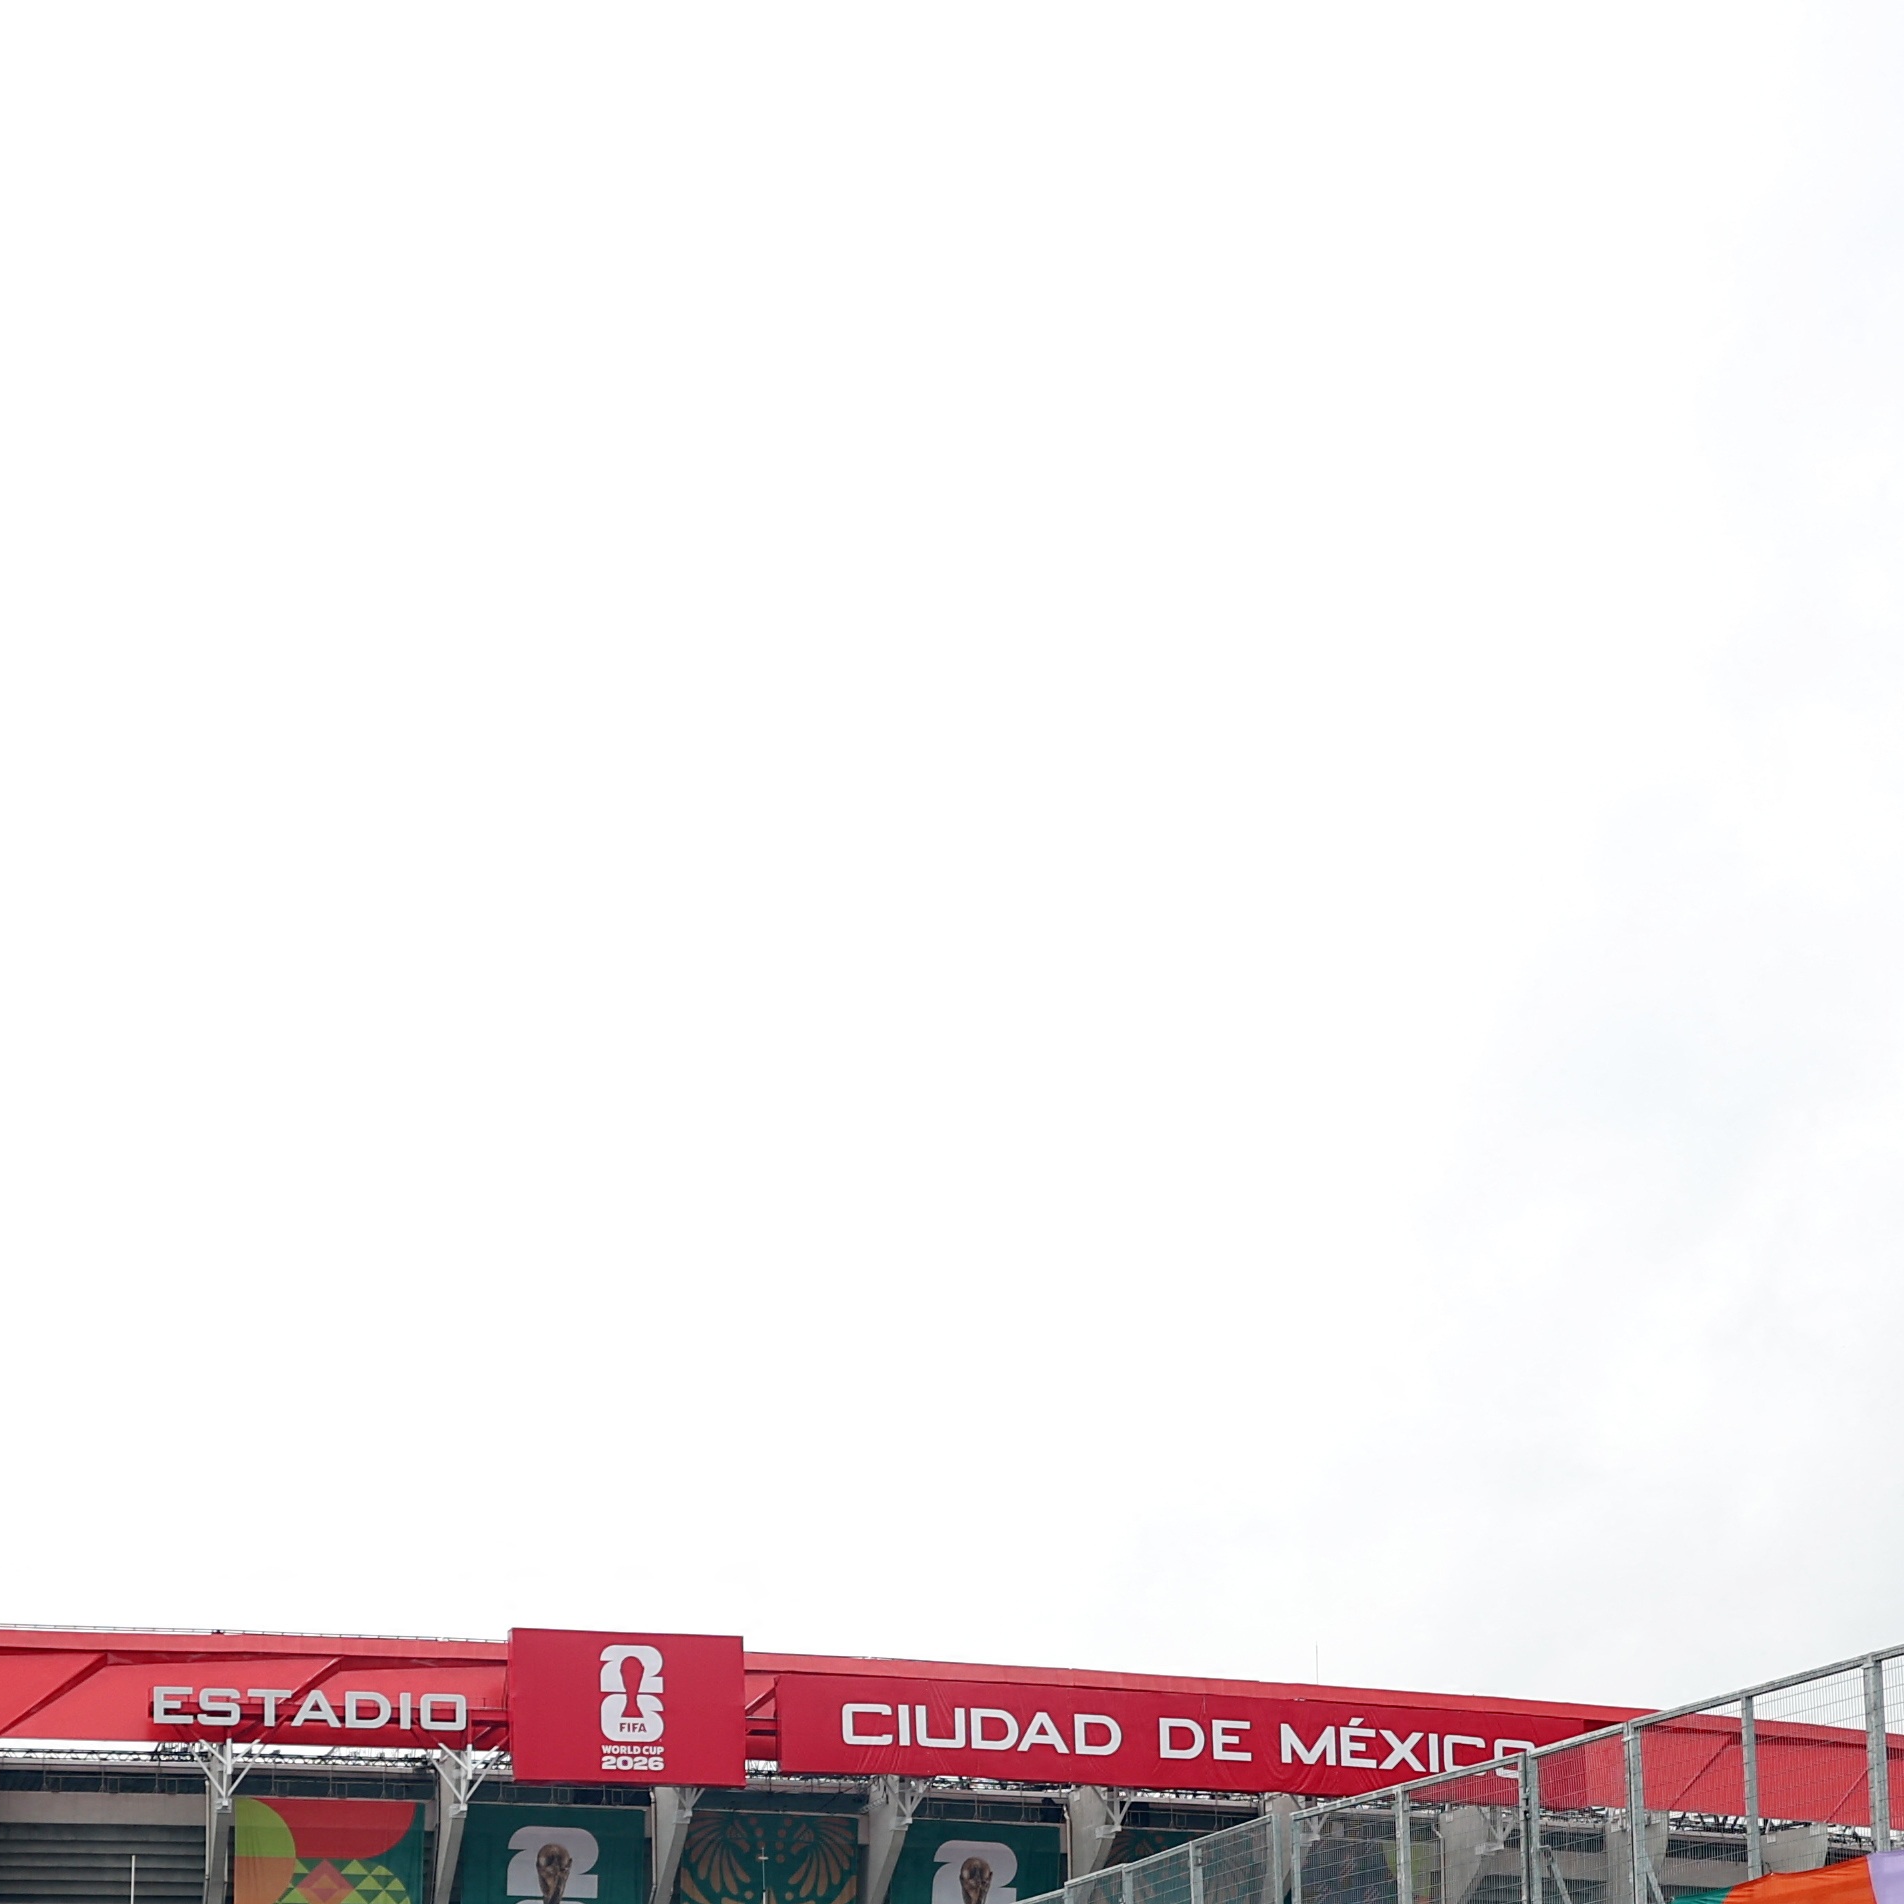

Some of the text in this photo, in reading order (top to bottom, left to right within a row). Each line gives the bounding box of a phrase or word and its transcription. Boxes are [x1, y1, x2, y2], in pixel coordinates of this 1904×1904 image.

[152, 1686, 467, 1731] ESTADIO
[619, 1722, 647, 1733] FIFA
[842, 1703, 1536, 1779] CIUDAD DE MÉXICO
[601, 1745, 664, 1755] WORLD CUP
[601, 1755, 664, 1771] 2026
